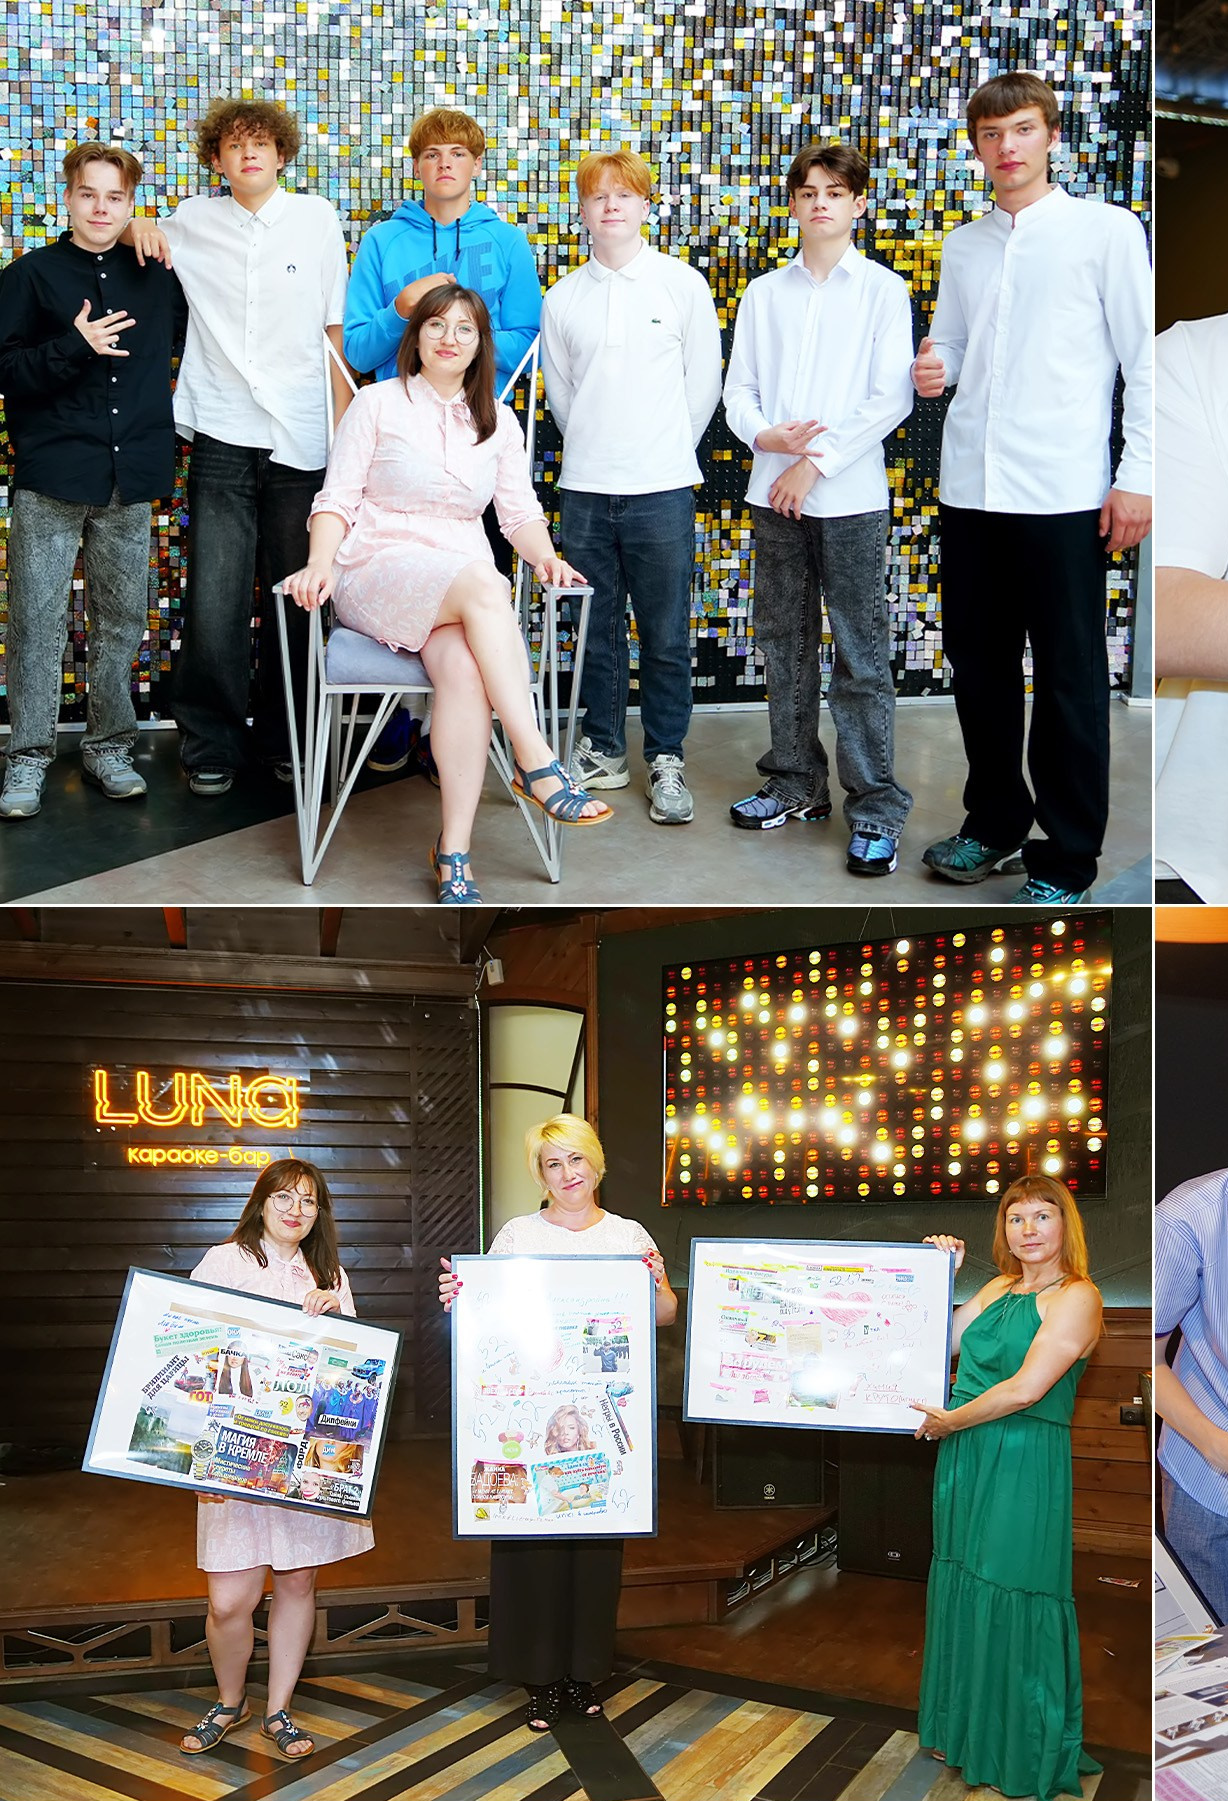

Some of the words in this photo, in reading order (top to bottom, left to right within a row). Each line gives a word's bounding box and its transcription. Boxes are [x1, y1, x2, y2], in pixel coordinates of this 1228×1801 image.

[127, 1146, 272, 1168] караоке-бар
[153, 1333, 178, 1343] Букет
[141, 1354, 181, 1394] БРИЛЛИАНТ
[147, 1384, 164, 1401] ДЛЯ
[160, 1355, 190, 1386] ЦАРИЦЫ
[320, 1414, 357, 1428] Дипфейки
[600, 1398, 613, 1421] Негры
[611, 1428, 627, 1455] России
[221, 1429, 257, 1449] МАГИЯ
[217, 1441, 226, 1453] В
[227, 1444, 269, 1465] КРЕМЛЕ
[296, 1441, 308, 1469] ФОРД
